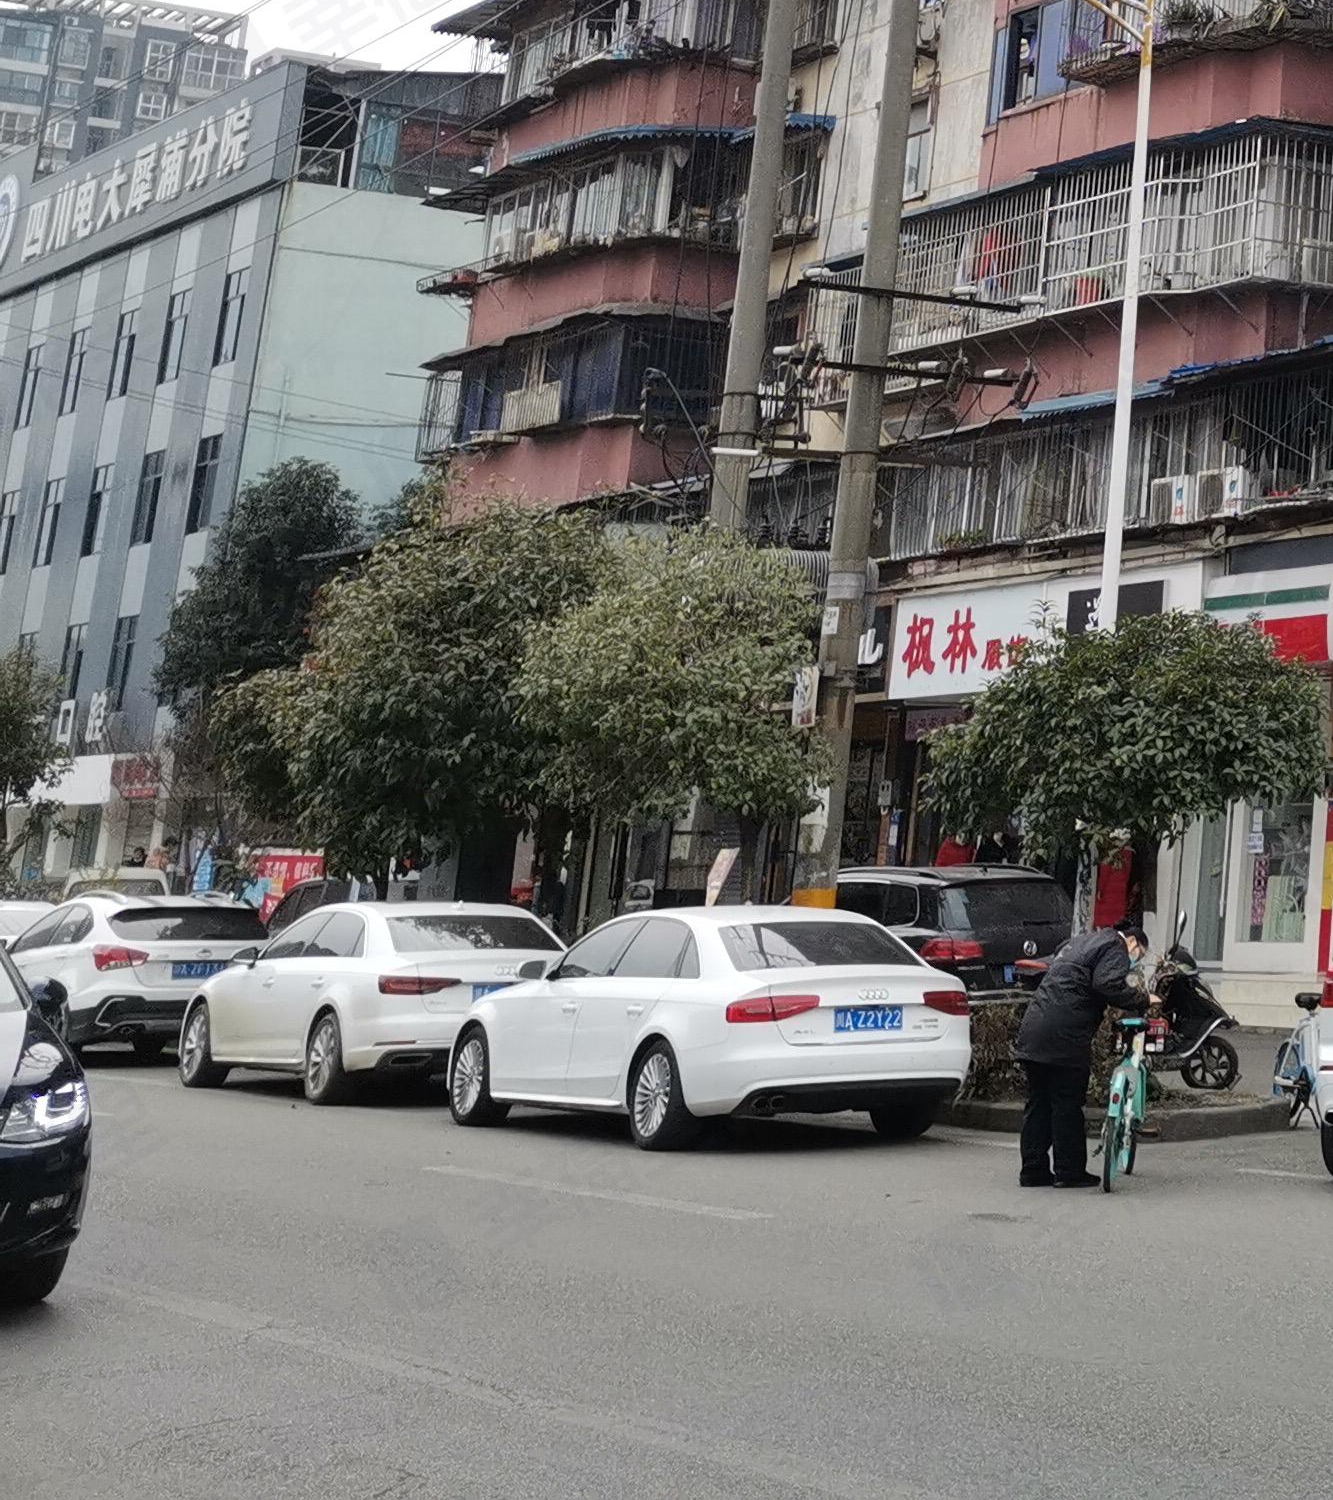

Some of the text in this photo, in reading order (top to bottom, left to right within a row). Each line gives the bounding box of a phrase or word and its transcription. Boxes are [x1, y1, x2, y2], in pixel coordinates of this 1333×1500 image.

[21, 98, 252, 263] 四川电大犀浦分院
[902, 607, 978, 678] 枫林
